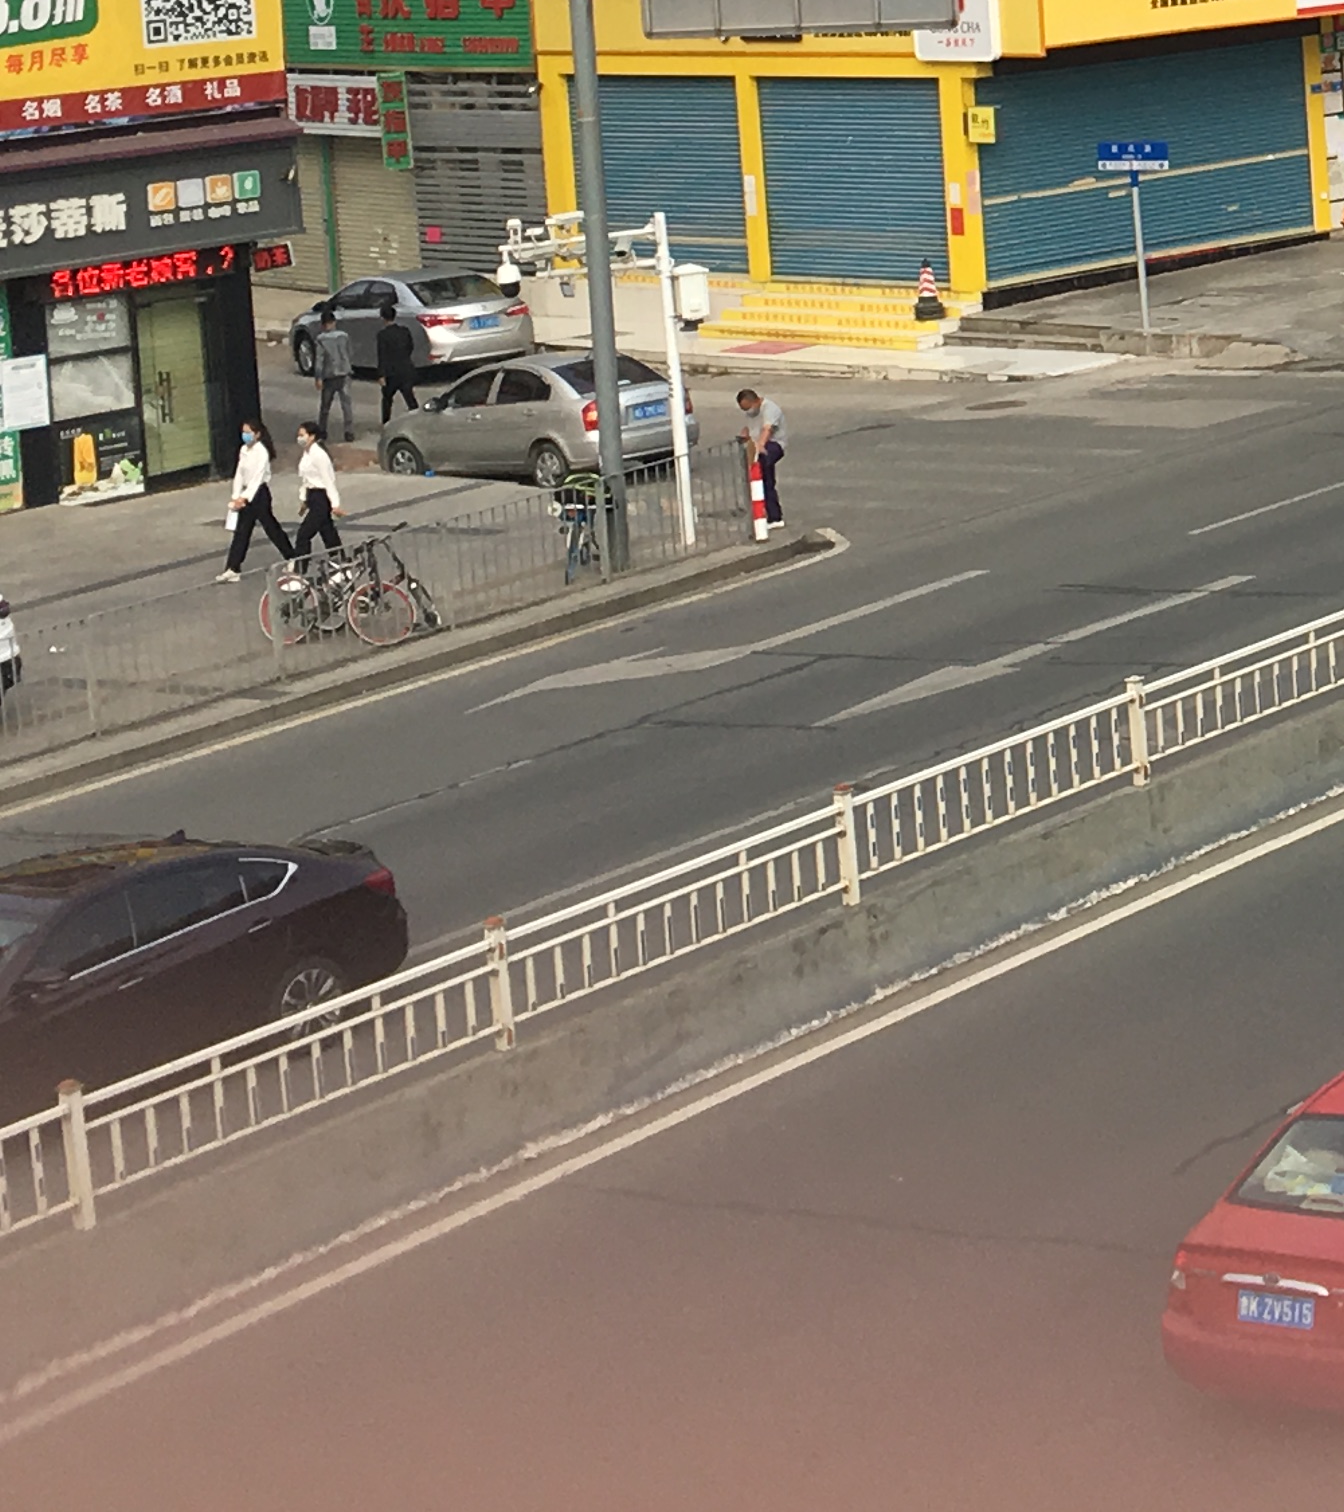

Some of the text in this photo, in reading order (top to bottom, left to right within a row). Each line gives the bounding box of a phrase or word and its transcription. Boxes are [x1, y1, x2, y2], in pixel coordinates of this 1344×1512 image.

[5, 43, 90, 76] 每月尽享
[134, 61, 170, 76] 扫一扫
[145, 85, 183, 107] 名酒
[203, 78, 241, 100] 礼品
[21, 98, 63, 122] 名烟
[84, 92, 123, 114] 名茶
